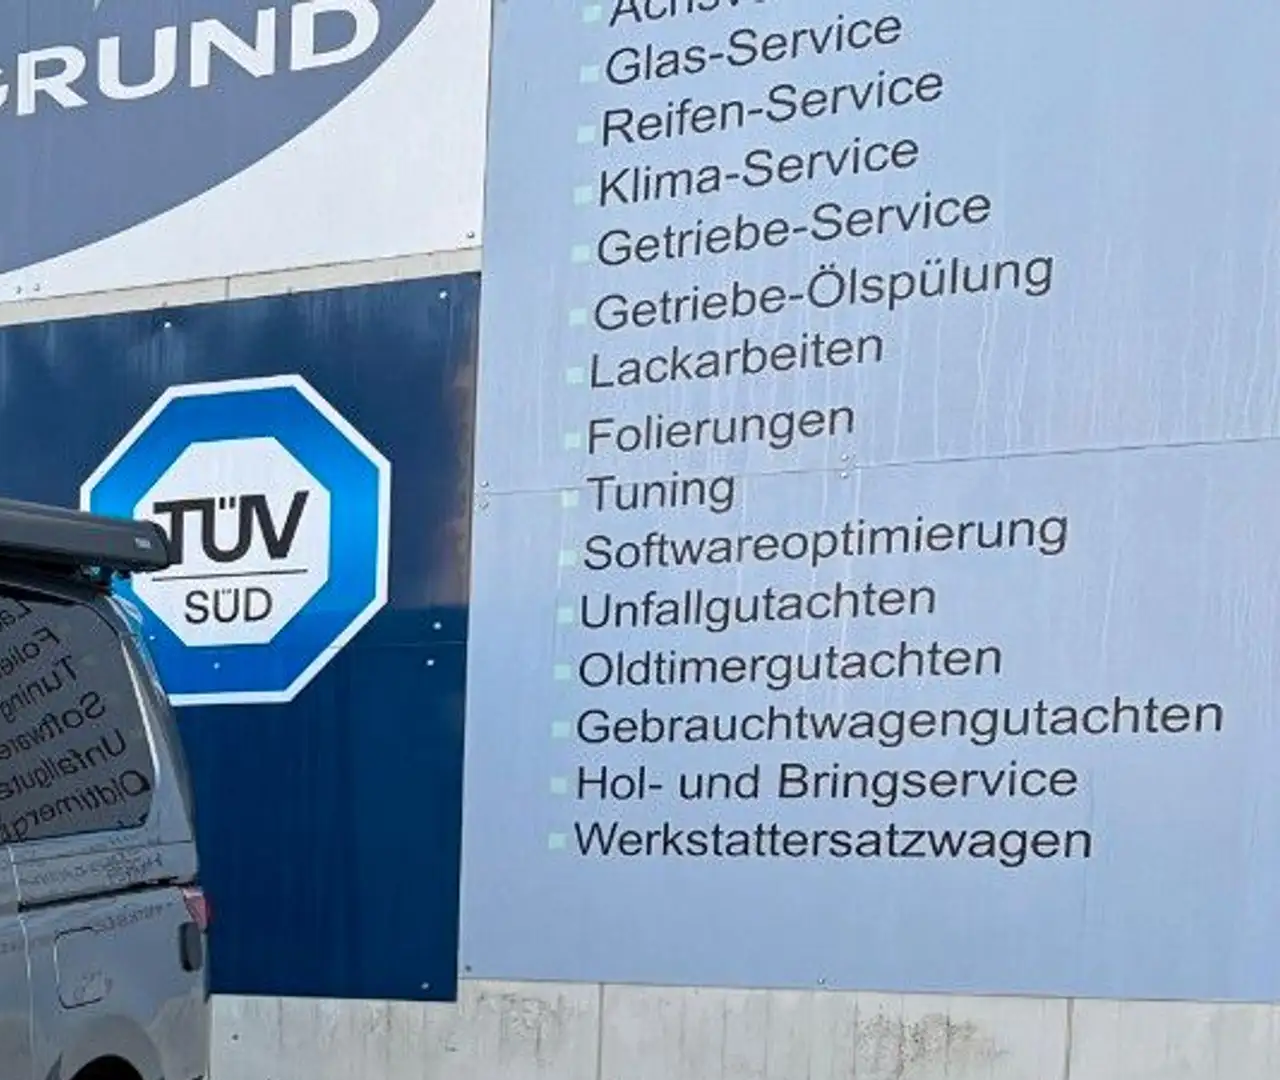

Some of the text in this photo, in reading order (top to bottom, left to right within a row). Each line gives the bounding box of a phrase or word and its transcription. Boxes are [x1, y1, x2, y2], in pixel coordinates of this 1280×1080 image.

[604, 14, 902, 85] Glas-Service
[601, 68, 944, 147] Reifen-Service
[598, 136, 920, 207] Klima-Service
[597, 190, 992, 267] Getriebe-Service
[593, 252, 1054, 331] Getriebe-Ölspülung
[590, 332, 884, 389] Lackarbeiten
[588, 406, 855, 455] Folierungen
[587, 471, 736, 515] Tuning
[153, 490, 310, 563] TÜV
[583, 513, 1069, 571] Softwareoptimierung
[185, 587, 272, 624] SÜD
[581, 582, 936, 633] Unfallgutachten
[578, 641, 1002, 692] Oldtimergutachten
[576, 696, 1223, 748] Gebrauchtwagengutachten
[577, 760, 1078, 808] Hol- und Bringservice
[574, 822, 1092, 868] Werkstattersatzwagen
